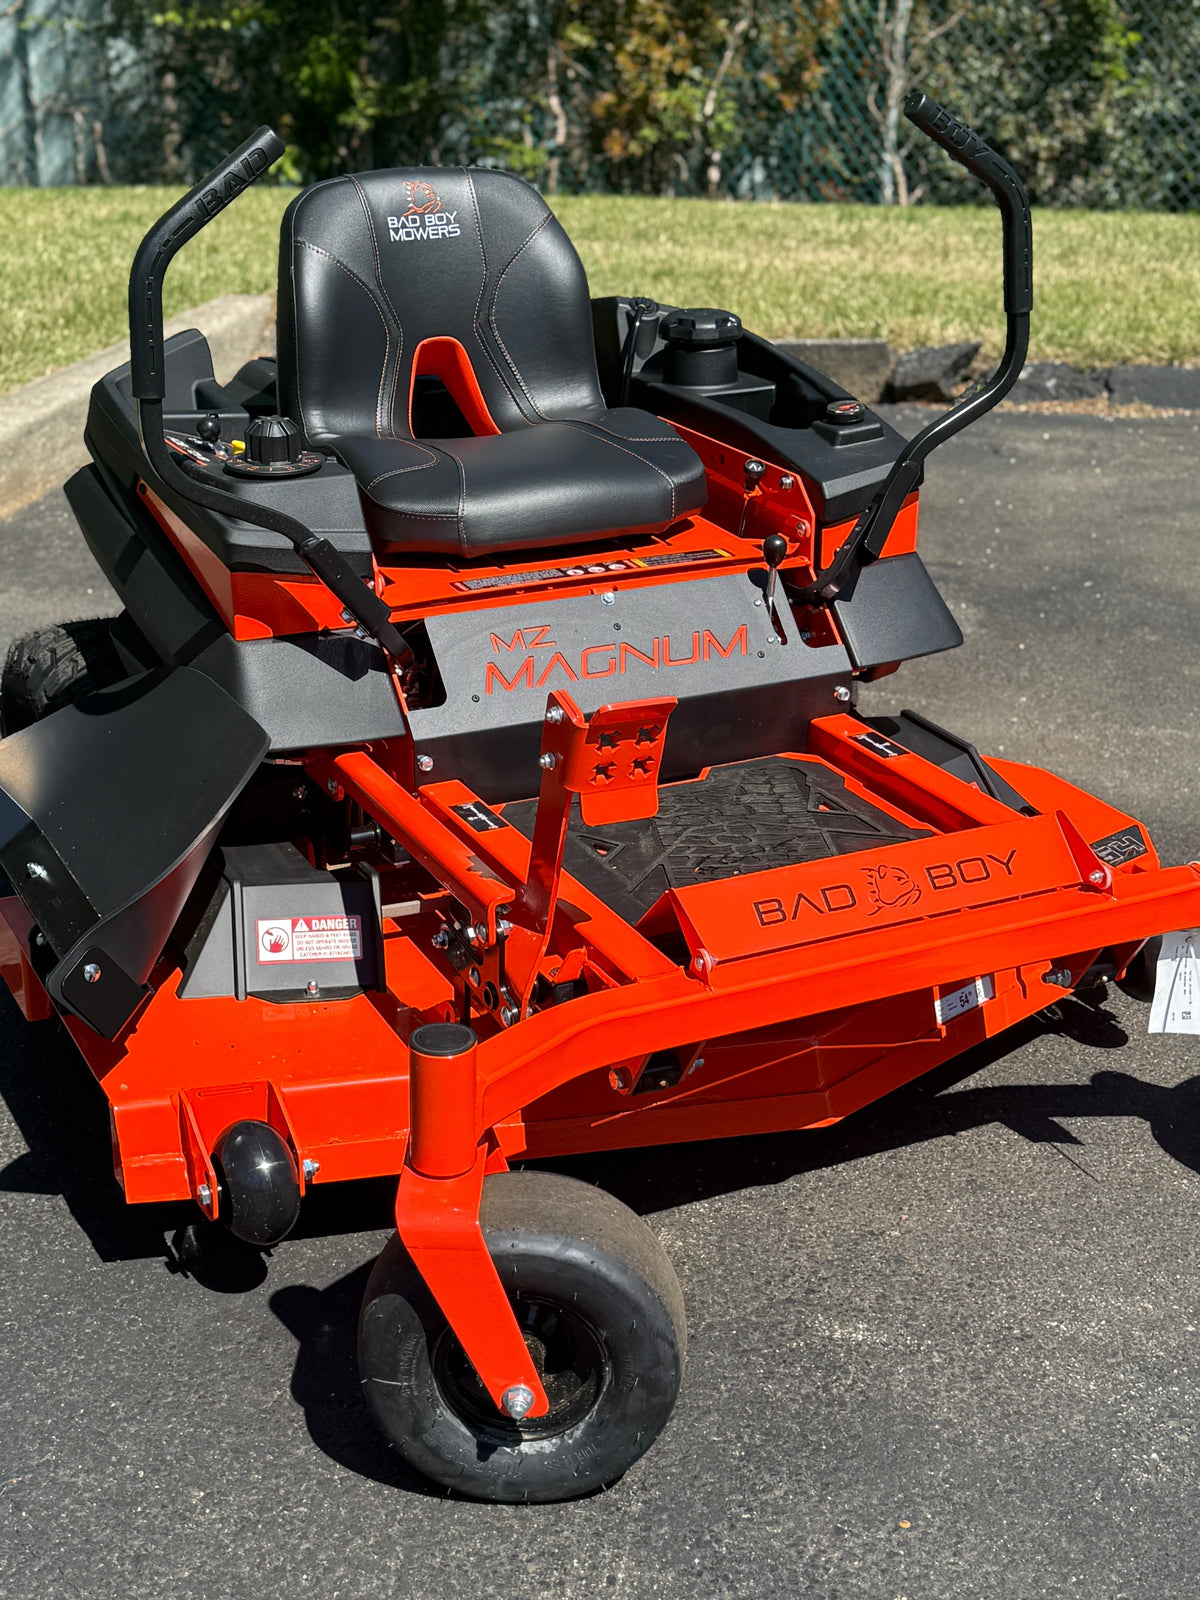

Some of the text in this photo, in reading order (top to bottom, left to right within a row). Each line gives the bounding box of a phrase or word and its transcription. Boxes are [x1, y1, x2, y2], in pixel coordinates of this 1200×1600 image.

[931, 106, 990, 159] BOY
[194, 147, 268, 221] BAD
[387, 210, 458, 229] BAD BOY
[389, 223, 461, 242] MOWERS
[489, 625, 557, 654] MZ
[485, 624, 748, 695] MAGNUM
[753, 849, 1017, 927] BAD BOY
[311, 918, 357, 931] DANGER
[959, 993, 970, 1008] 54
